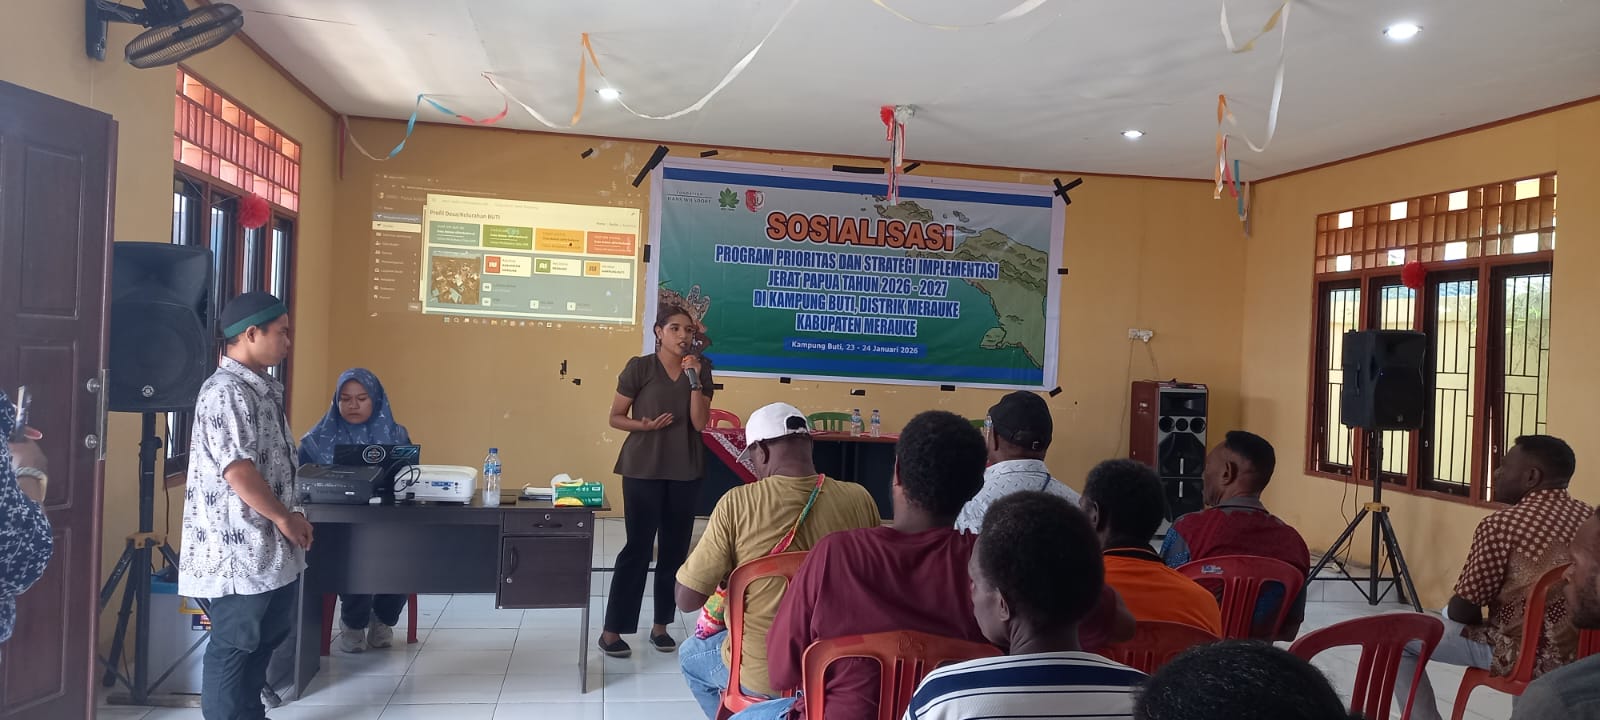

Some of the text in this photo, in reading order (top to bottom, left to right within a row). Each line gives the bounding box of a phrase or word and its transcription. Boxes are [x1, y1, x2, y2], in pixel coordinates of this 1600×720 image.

[766, 211, 955, 252] SOSIALISASI
[715, 245, 999, 279] PROGRAM PRIORITAS DAN STRATEGI IMPLEMENTASI
[768, 270, 801, 288] JERAT
[802, 272, 840, 290] PAPUA
[842, 274, 879, 292] TAHUN
[881, 277, 911, 295] 2026
[919, 280, 948, 297] 2027
[754, 290, 960, 318] DI KAMPUNG BUTI, DISTRIK MERAUKE
[796, 313, 917, 336] KABUPATEN MERAUKE
[791, 341, 826, 350] Kampung
[827, 342, 844, 351] Buti,
[873, 345, 899, 353] Januari
[900, 346, 919, 354] 2026
